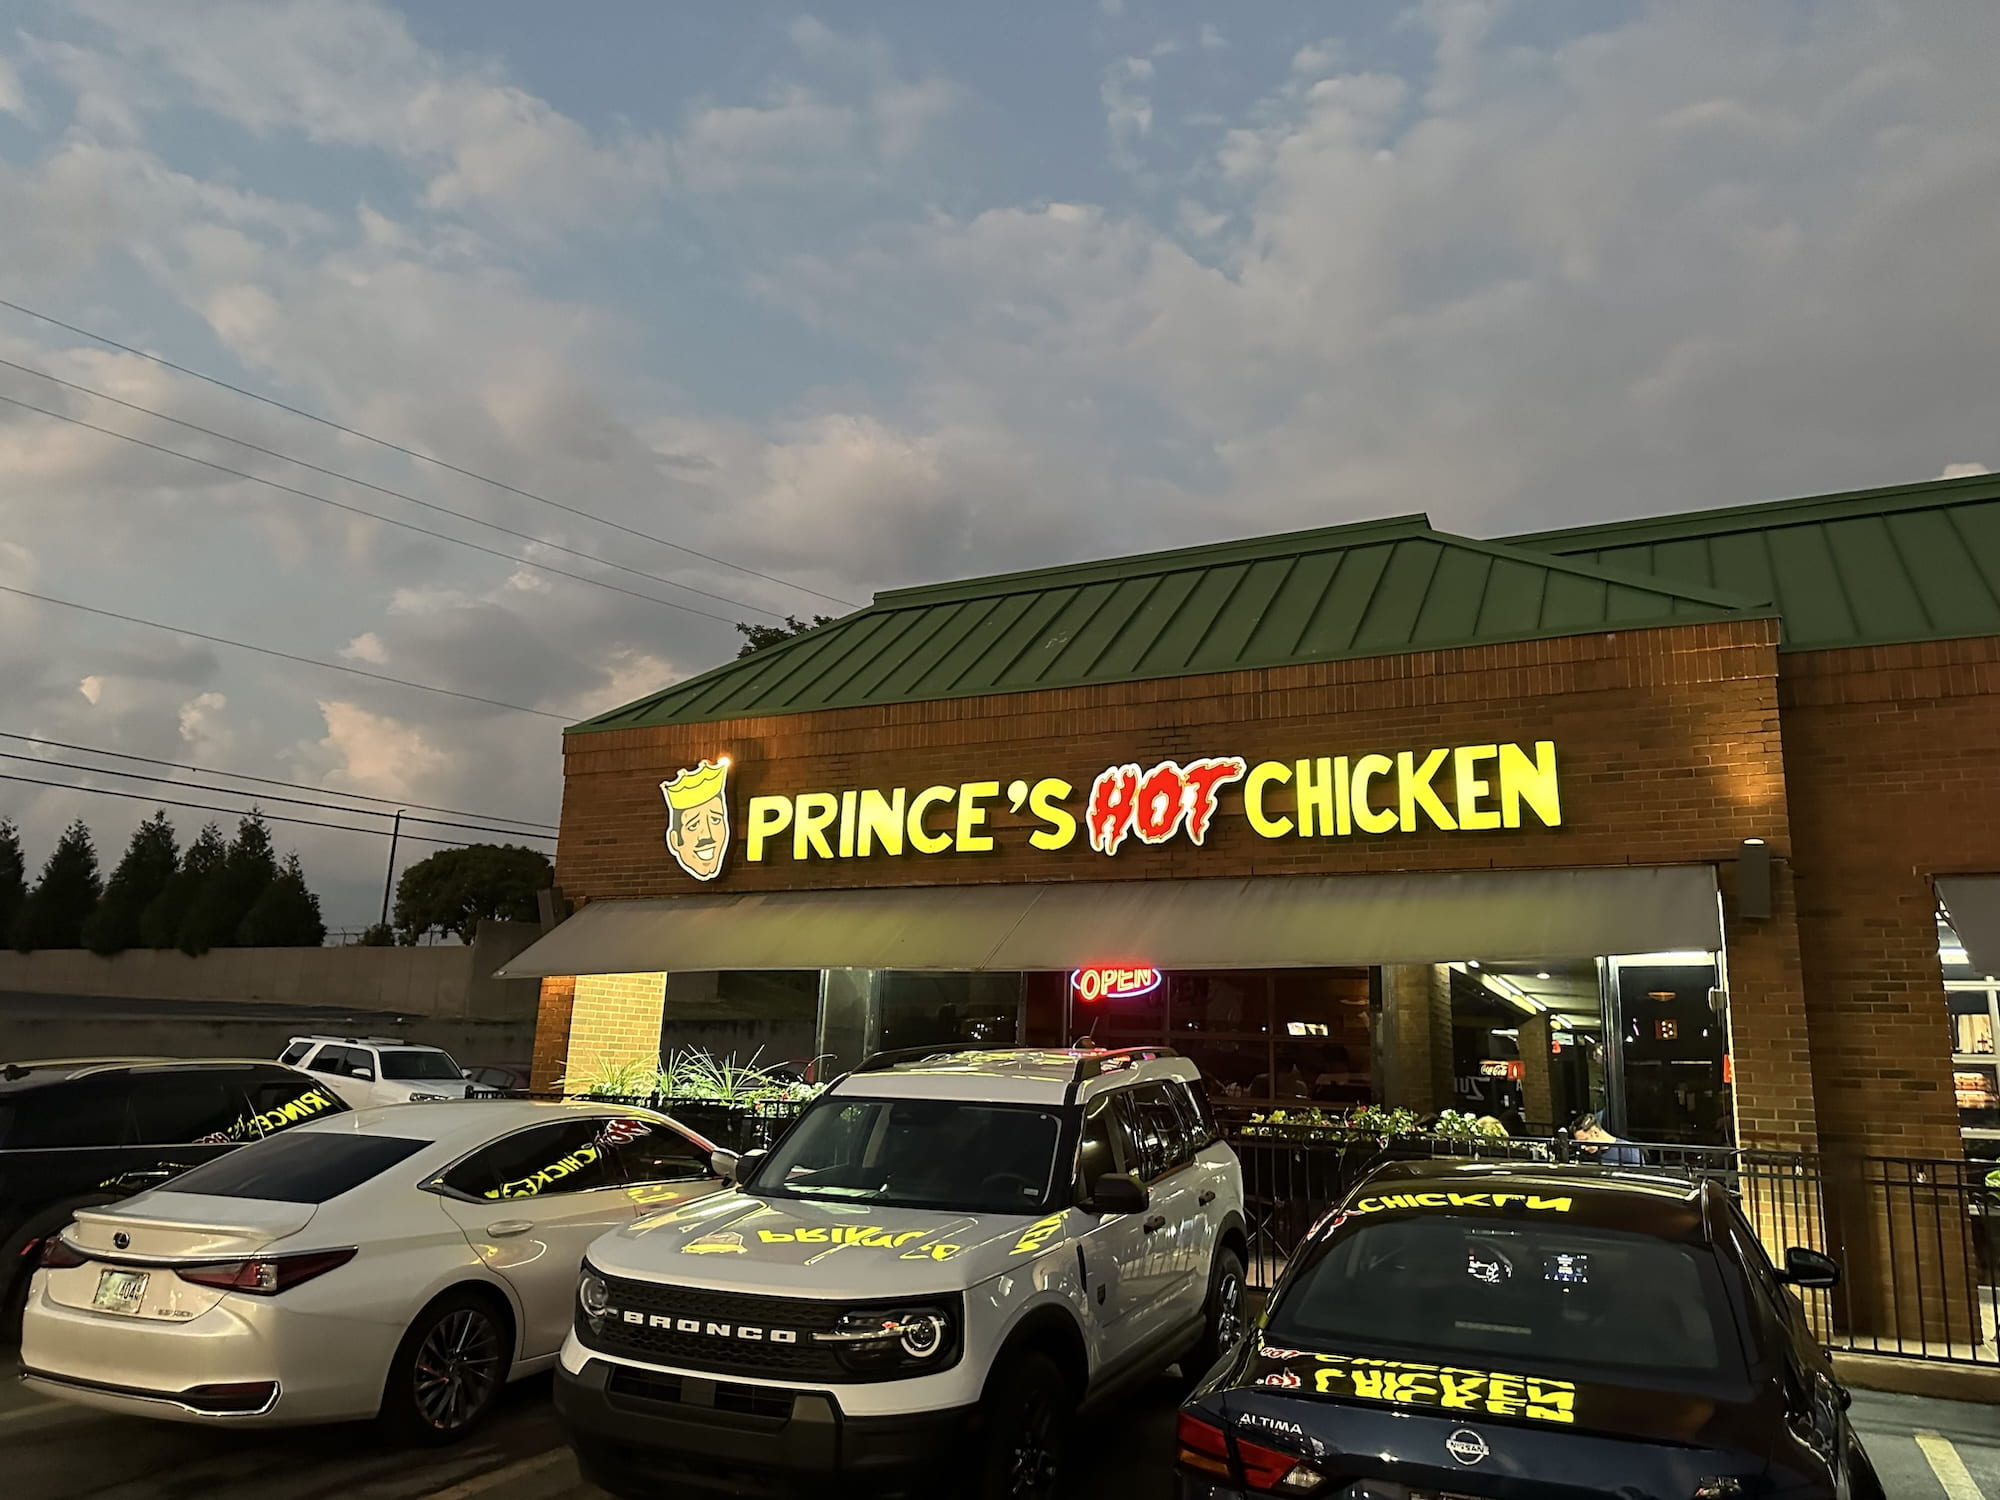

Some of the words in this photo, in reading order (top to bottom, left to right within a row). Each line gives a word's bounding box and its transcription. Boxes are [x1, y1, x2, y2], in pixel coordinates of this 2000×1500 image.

[746, 777, 1077, 862] PRINCE'S
[1085, 756, 1247, 857] HOT
[1244, 741, 1561, 838] CHICKEN
[1079, 968, 1152, 1000] OPEN
[624, 1311, 796, 1343] BRONCO
[1239, 1412, 1303, 1435] ALTIMA
[1449, 1441, 1485, 1454] NISSAN
